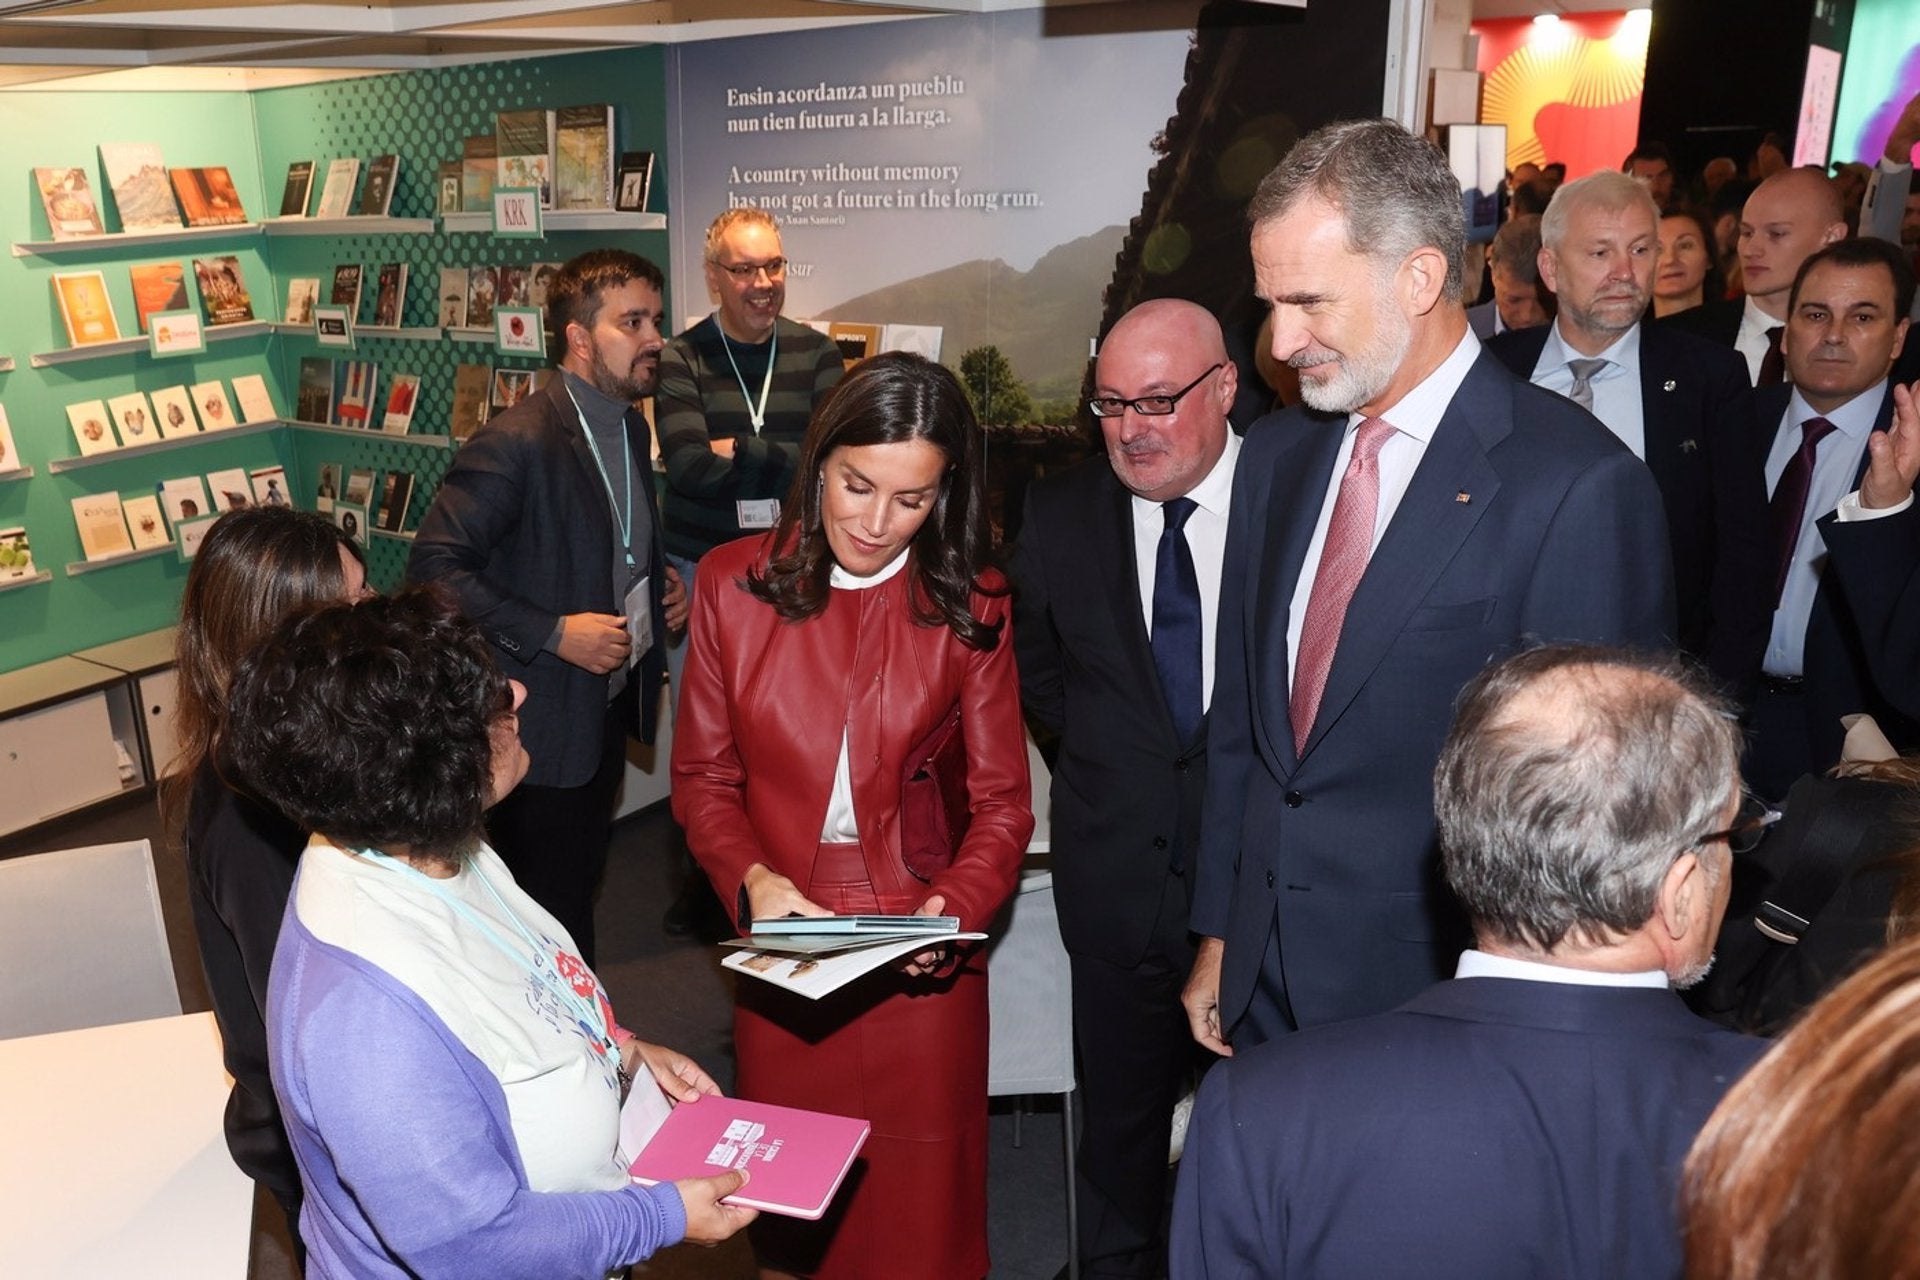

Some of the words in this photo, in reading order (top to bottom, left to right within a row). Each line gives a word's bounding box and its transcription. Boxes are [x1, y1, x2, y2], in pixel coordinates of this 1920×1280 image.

[727, 87, 773, 107] Ensin
[776, 82, 867, 104] acordanza
[871, 85, 895, 99] un
[898, 75, 964, 102] pueblu
[727, 117, 759, 133] nun
[762, 112, 795, 131] tien
[799, 110, 855, 130] futuru
[858, 113, 868, 127] a
[872, 108, 889, 126] la
[893, 105, 951, 129] llarga.
[728, 165, 741, 184] A
[744, 166, 809, 186] country
[812, 163, 880, 182] without
[884, 164, 962, 184] memory
[503, 198, 528, 226] KRK
[728, 192, 757, 209] has
[760, 191, 788, 209] not
[792, 193, 820, 212] got
[823, 194, 834, 209] a
[836, 190, 894, 209] future
[897, 190, 916, 208] in
[919, 189, 952, 208] the
[954, 189, 999, 211] long
[1003, 190, 1045, 208] run.
